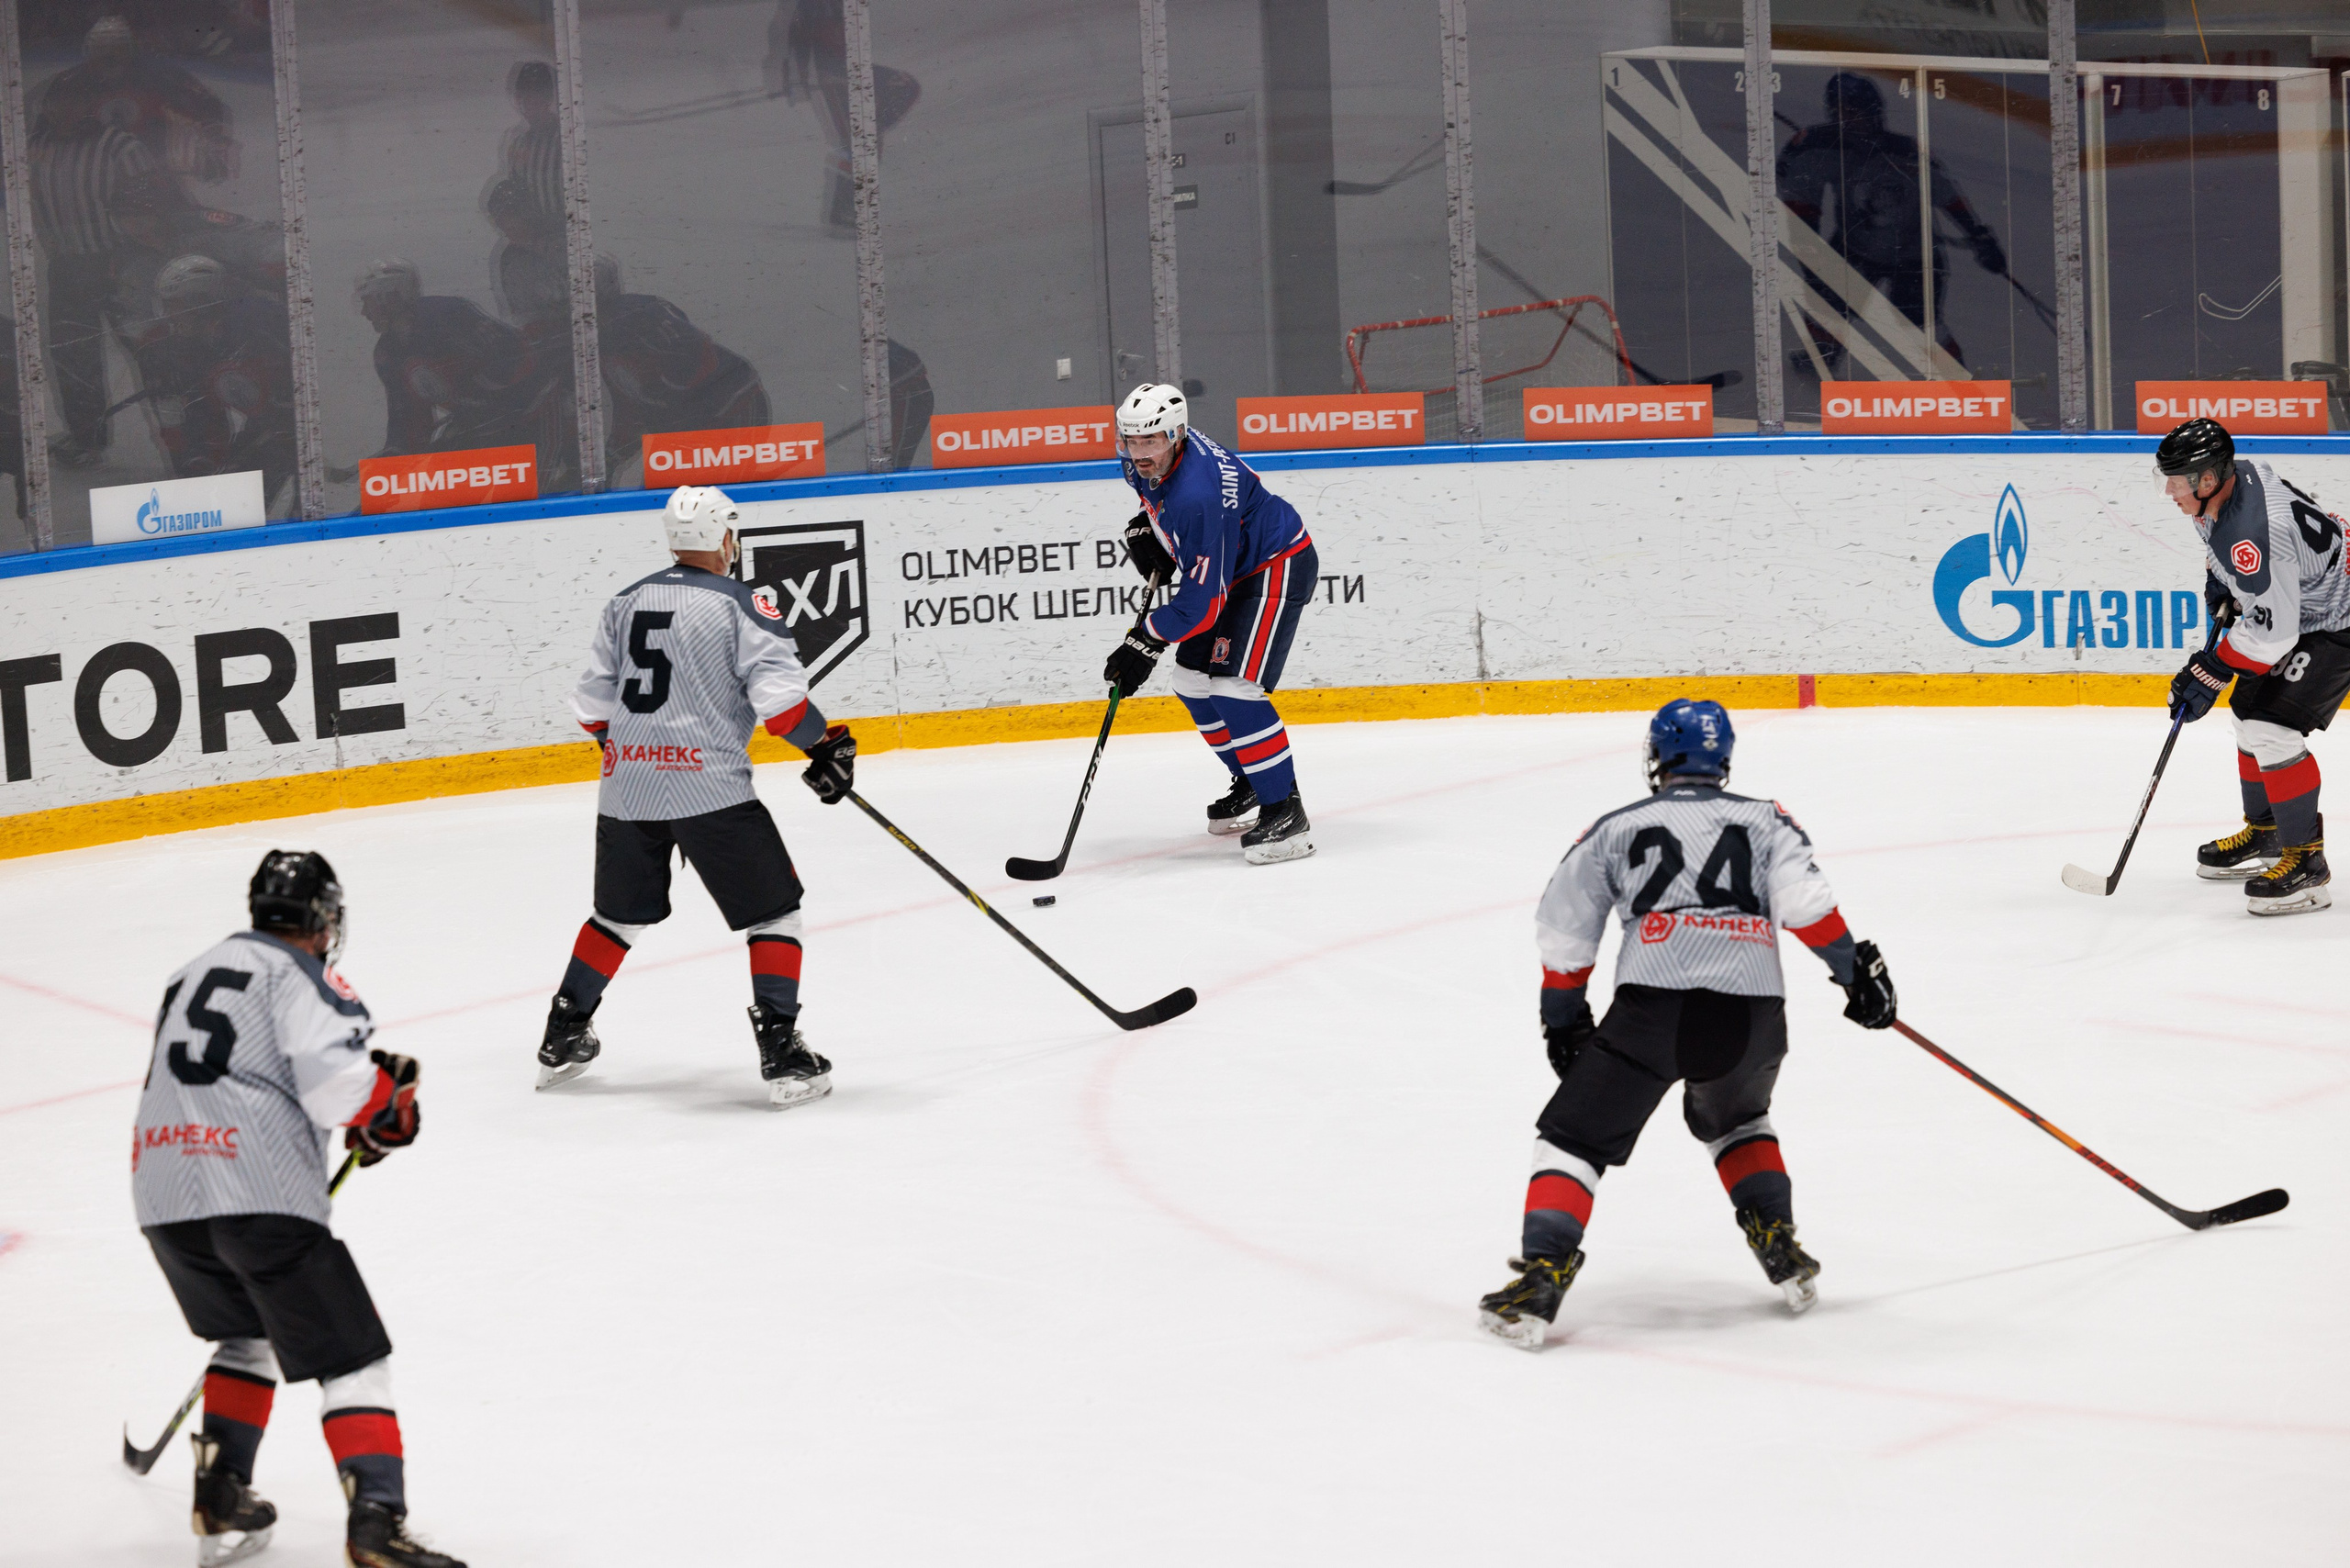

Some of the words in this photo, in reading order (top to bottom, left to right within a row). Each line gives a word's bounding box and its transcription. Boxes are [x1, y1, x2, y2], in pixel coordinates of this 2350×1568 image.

[1610, 67, 1619, 87] 1
[1734, 71, 1745, 93] 2
[1898, 77, 1910, 98] 4
[1933, 78, 1946, 100] 5
[2110, 84, 2121, 106] 7
[2256, 88, 2270, 111] 8
[1529, 401, 1707, 424] OLIMPBET
[1827, 398, 2006, 418] OLIMPBET
[2142, 398, 2322, 418] OLIMPBET
[1243, 409, 1418, 434] OLIMPBET
[936, 422, 1110, 452] OLIMPBET
[649, 441, 819, 471] OLIMPBET
[365, 464, 531, 496] OLIMPBET
[162, 510, 223, 533] ГАЗПРОМ
[901, 542, 1081, 581] OLIMPBET
[1096, 539, 1136, 569] ВХ
[904, 592, 1020, 629] КУБОК
[2042, 589, 2231, 649] ГАЗПР
[1125, 636, 1162, 660] BAUE
[621, 610, 675, 714] 5
[0, 611, 406, 782] TORE
[621, 745, 703, 764] КАНЕКС
[1628, 824, 1761, 917] 24
[145, 1124, 239, 1149] КАНЕКС
